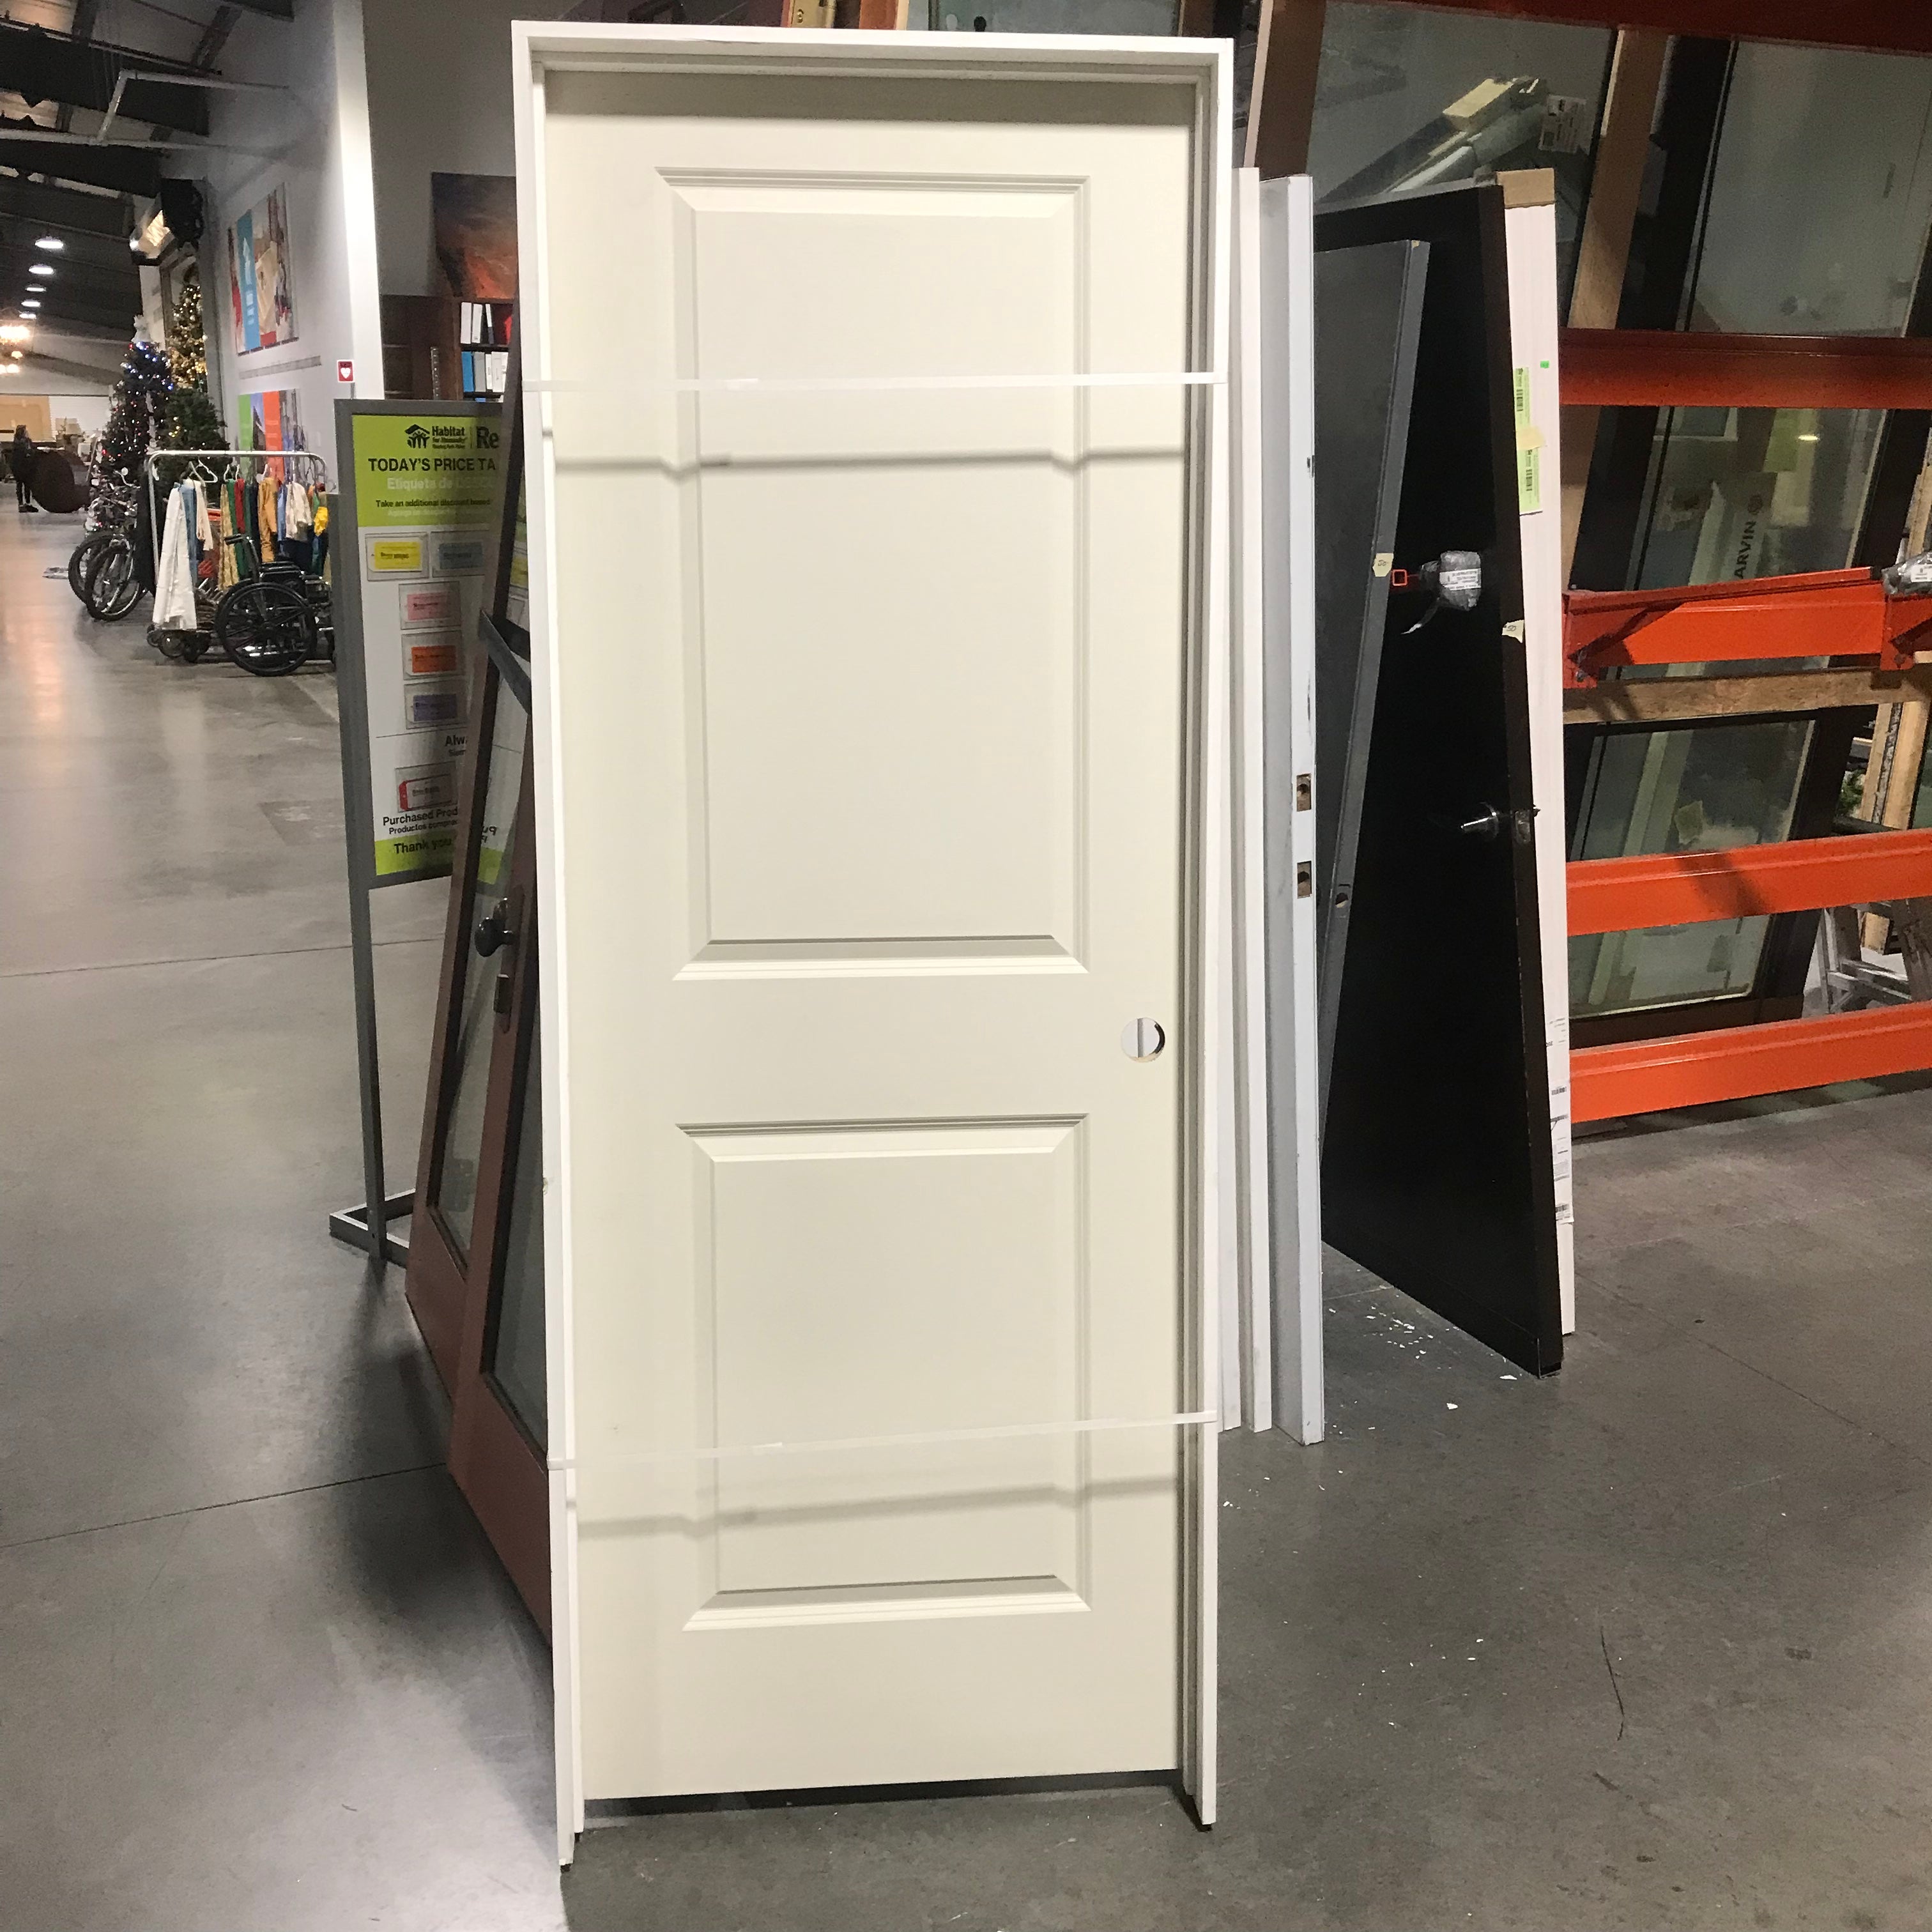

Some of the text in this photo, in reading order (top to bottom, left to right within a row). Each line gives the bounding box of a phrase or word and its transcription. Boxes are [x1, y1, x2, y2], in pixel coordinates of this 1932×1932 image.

[432, 425, 465, 436] Habitat
[477, 426, 499, 448] Re
[368, 458, 496, 471] TODAY'S PRICE TA
[387, 478, 437, 491] Etiqueta
[1734, 521, 1756, 579] ARVIN
[383, 806, 458, 826] Purchased Prod
[388, 823, 427, 834] Productos
[394, 838, 452, 854] Thank you
